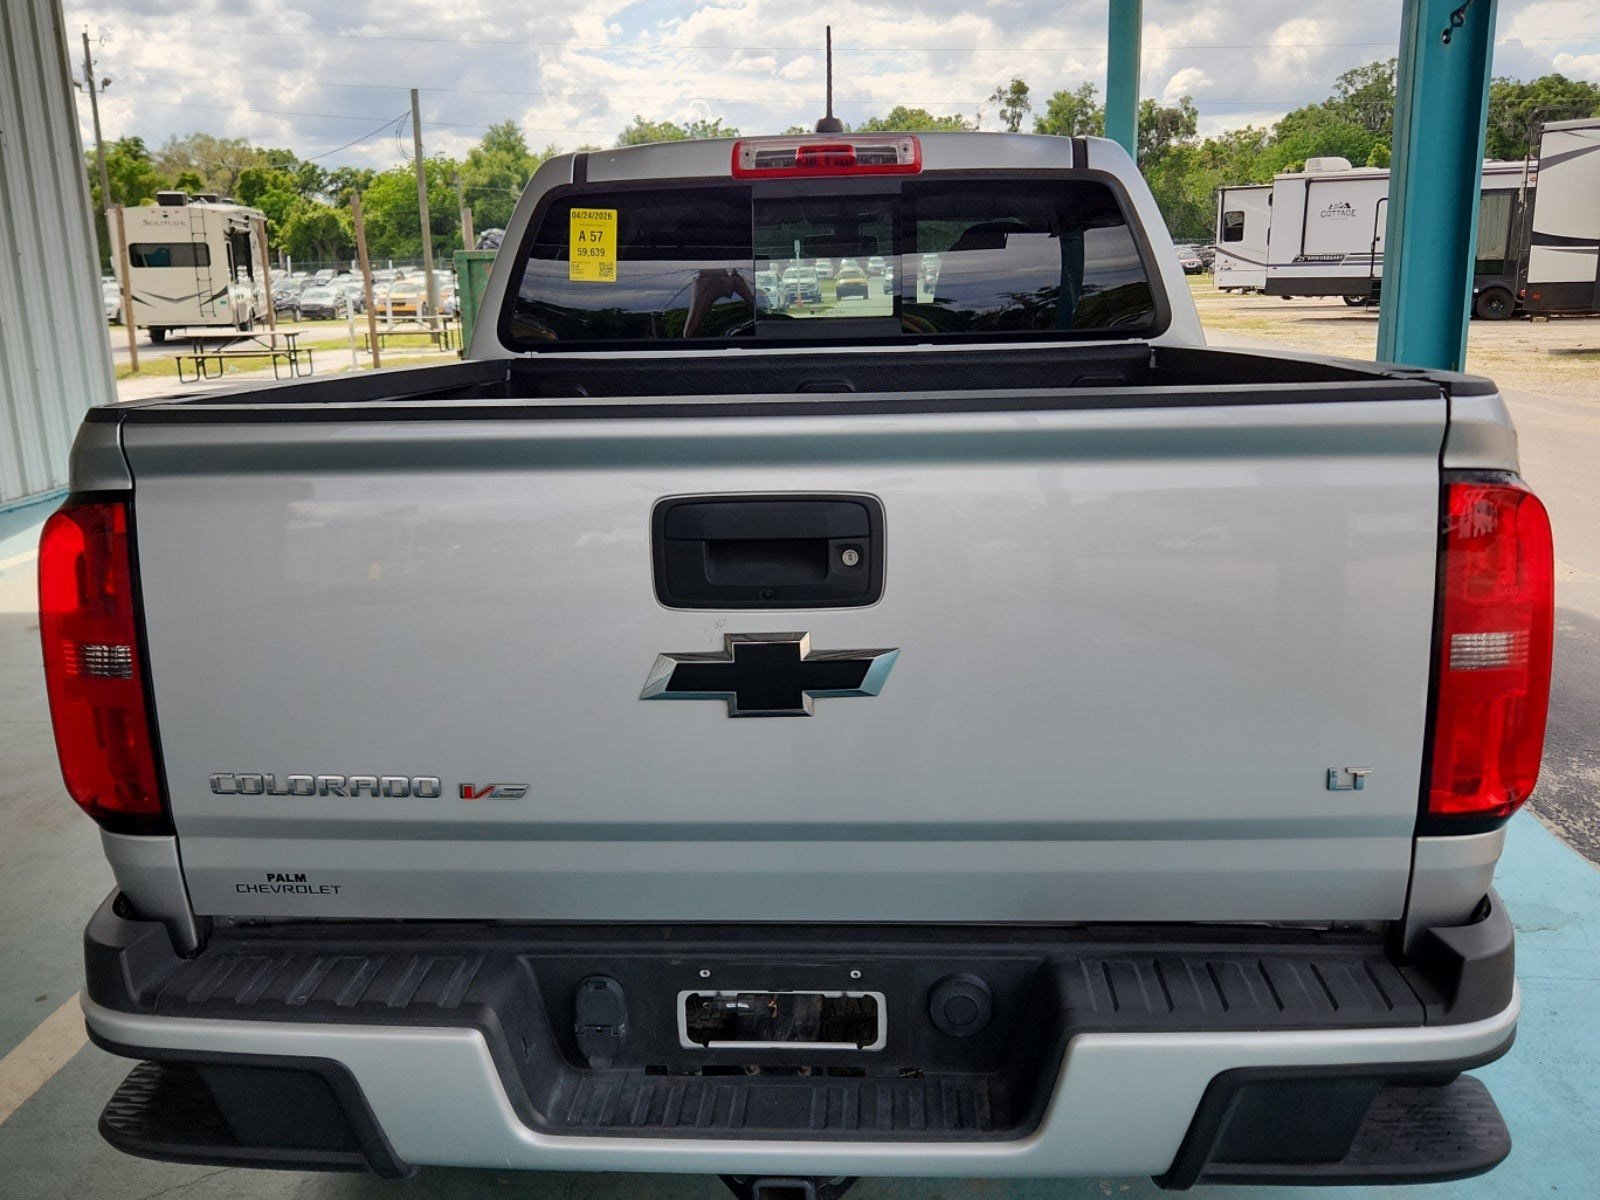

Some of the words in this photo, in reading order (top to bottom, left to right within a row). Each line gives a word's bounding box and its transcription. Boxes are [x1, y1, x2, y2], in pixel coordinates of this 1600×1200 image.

[571, 211, 613, 221] 04/24/2026
[1320, 209, 1357, 218] COTTAGE
[578, 230, 586, 242] A
[590, 230, 603, 242] 57
[577, 247, 605, 258] 59,639
[1326, 767, 1375, 791] LT
[210, 772, 441, 798] COLORADO
[459, 783, 530, 799] V6
[266, 873, 307, 882] PALM
[235, 883, 341, 895] CHEVROLET
